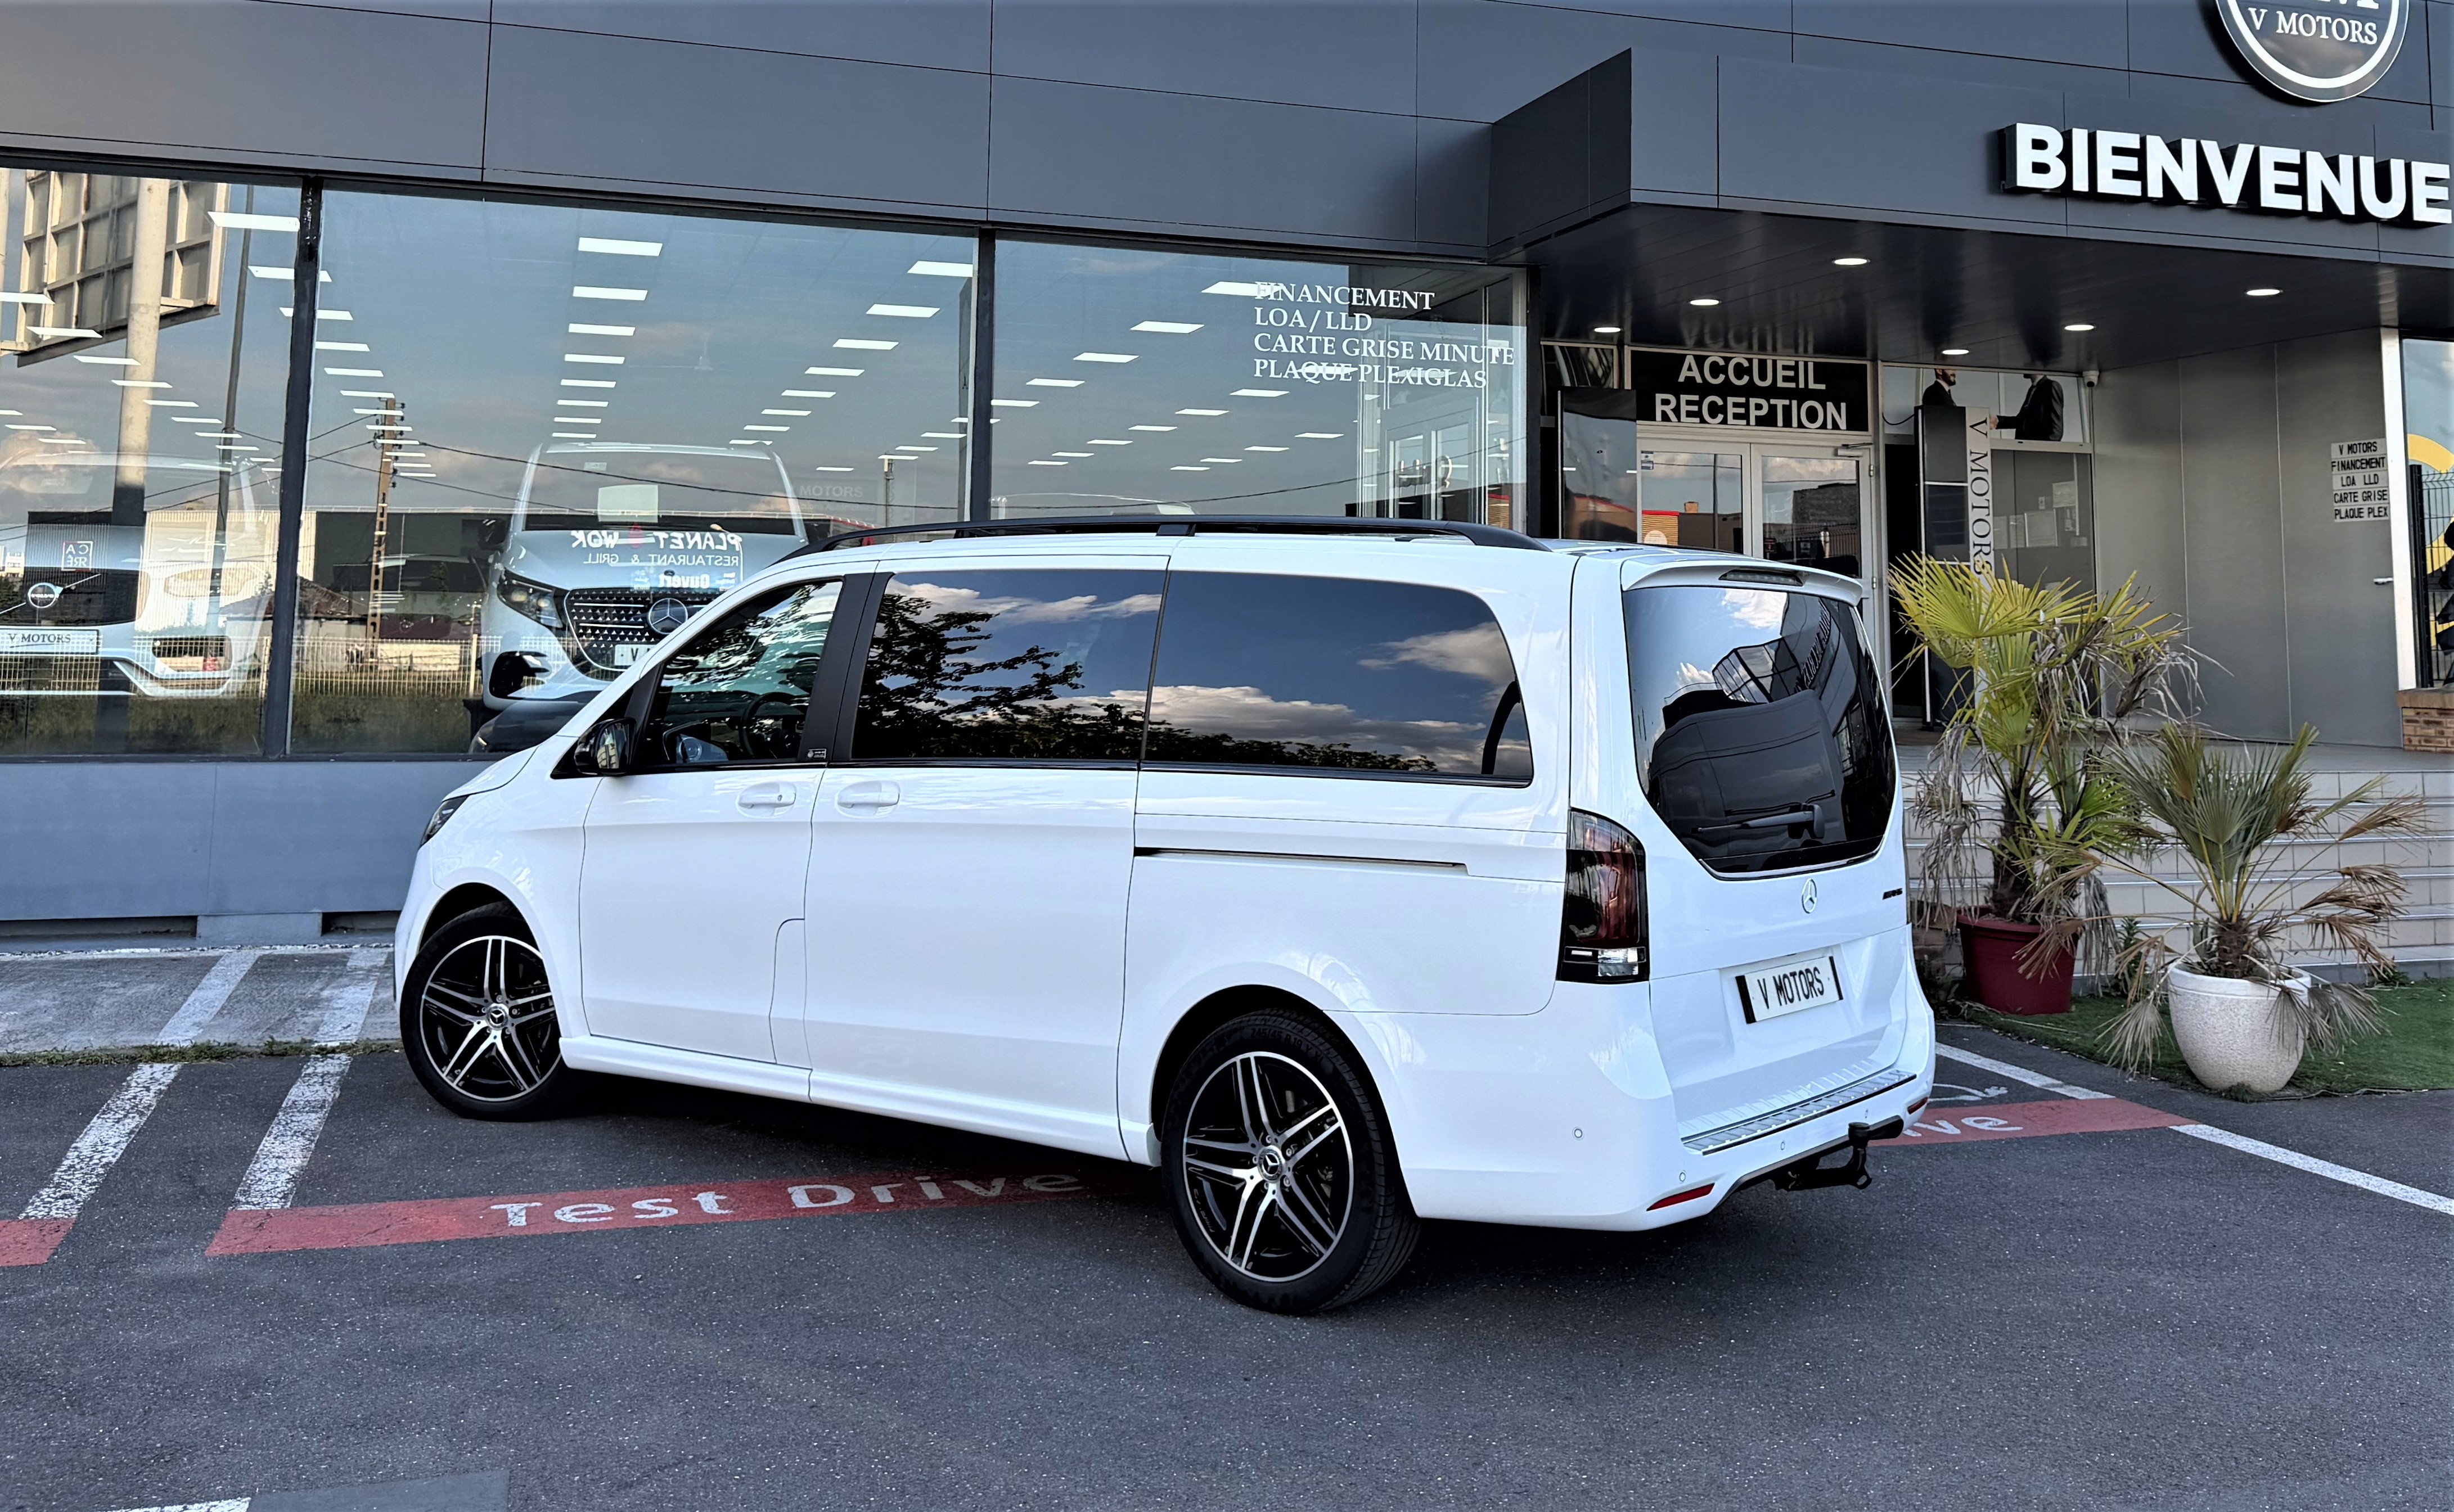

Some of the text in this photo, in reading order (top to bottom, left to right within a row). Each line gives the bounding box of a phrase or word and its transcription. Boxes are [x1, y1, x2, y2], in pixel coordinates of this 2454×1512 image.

[2248, 7, 2378, 45] V MOTORS
[2016, 122, 2453, 224] BIENVENUE
[1255, 281, 1435, 310] FINANCEMENT
[1254, 333, 1515, 365] CARTE GRISE MINUTE
[1254, 358, 1487, 389] PLAQUE PLEXIGLAS
[1677, 354, 1826, 390] ACCUEIL
[1655, 393, 1847, 430] RECEPTION
[2339, 441, 2378, 455] V MOTORS
[2331, 457, 2385, 472] FINANCEMENT
[2341, 473, 2380, 487] LOA LLD
[1969, 417, 1993, 576] V MOTORS
[2334, 489, 2388, 504] CARTE GRISE
[2334, 506, 2389, 520] PLAQUE PLEX
[8, 633, 71, 643] V MOTORS
[1757, 966, 1825, 1010] V MOTORS
[490, 1175, 1083, 1227] Test Drive
